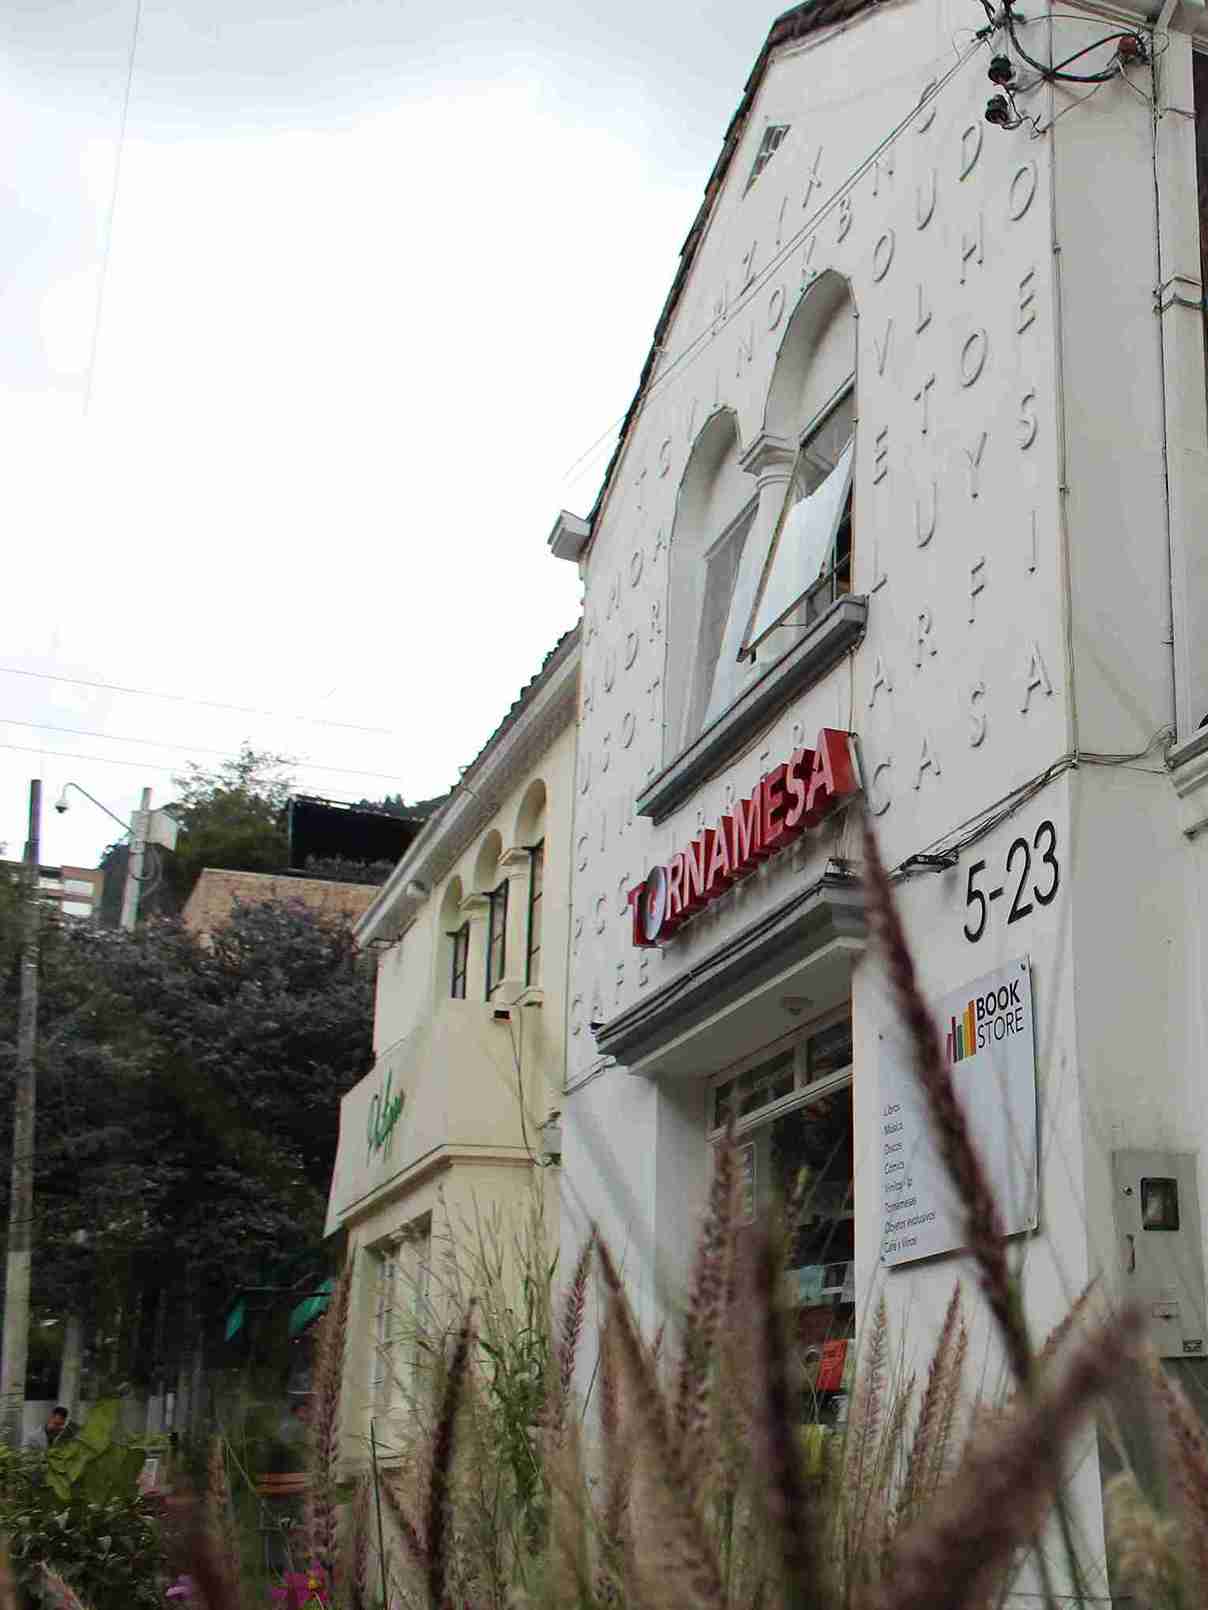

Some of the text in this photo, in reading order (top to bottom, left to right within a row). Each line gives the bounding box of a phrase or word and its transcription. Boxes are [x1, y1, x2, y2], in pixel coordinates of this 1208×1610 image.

[627, 727, 850, 947] TORNAMESA
[963, 820, 1060, 944] 5-23
[976, 979, 1021, 1022] BOOK
[977, 1007, 1025, 1050] STORE
